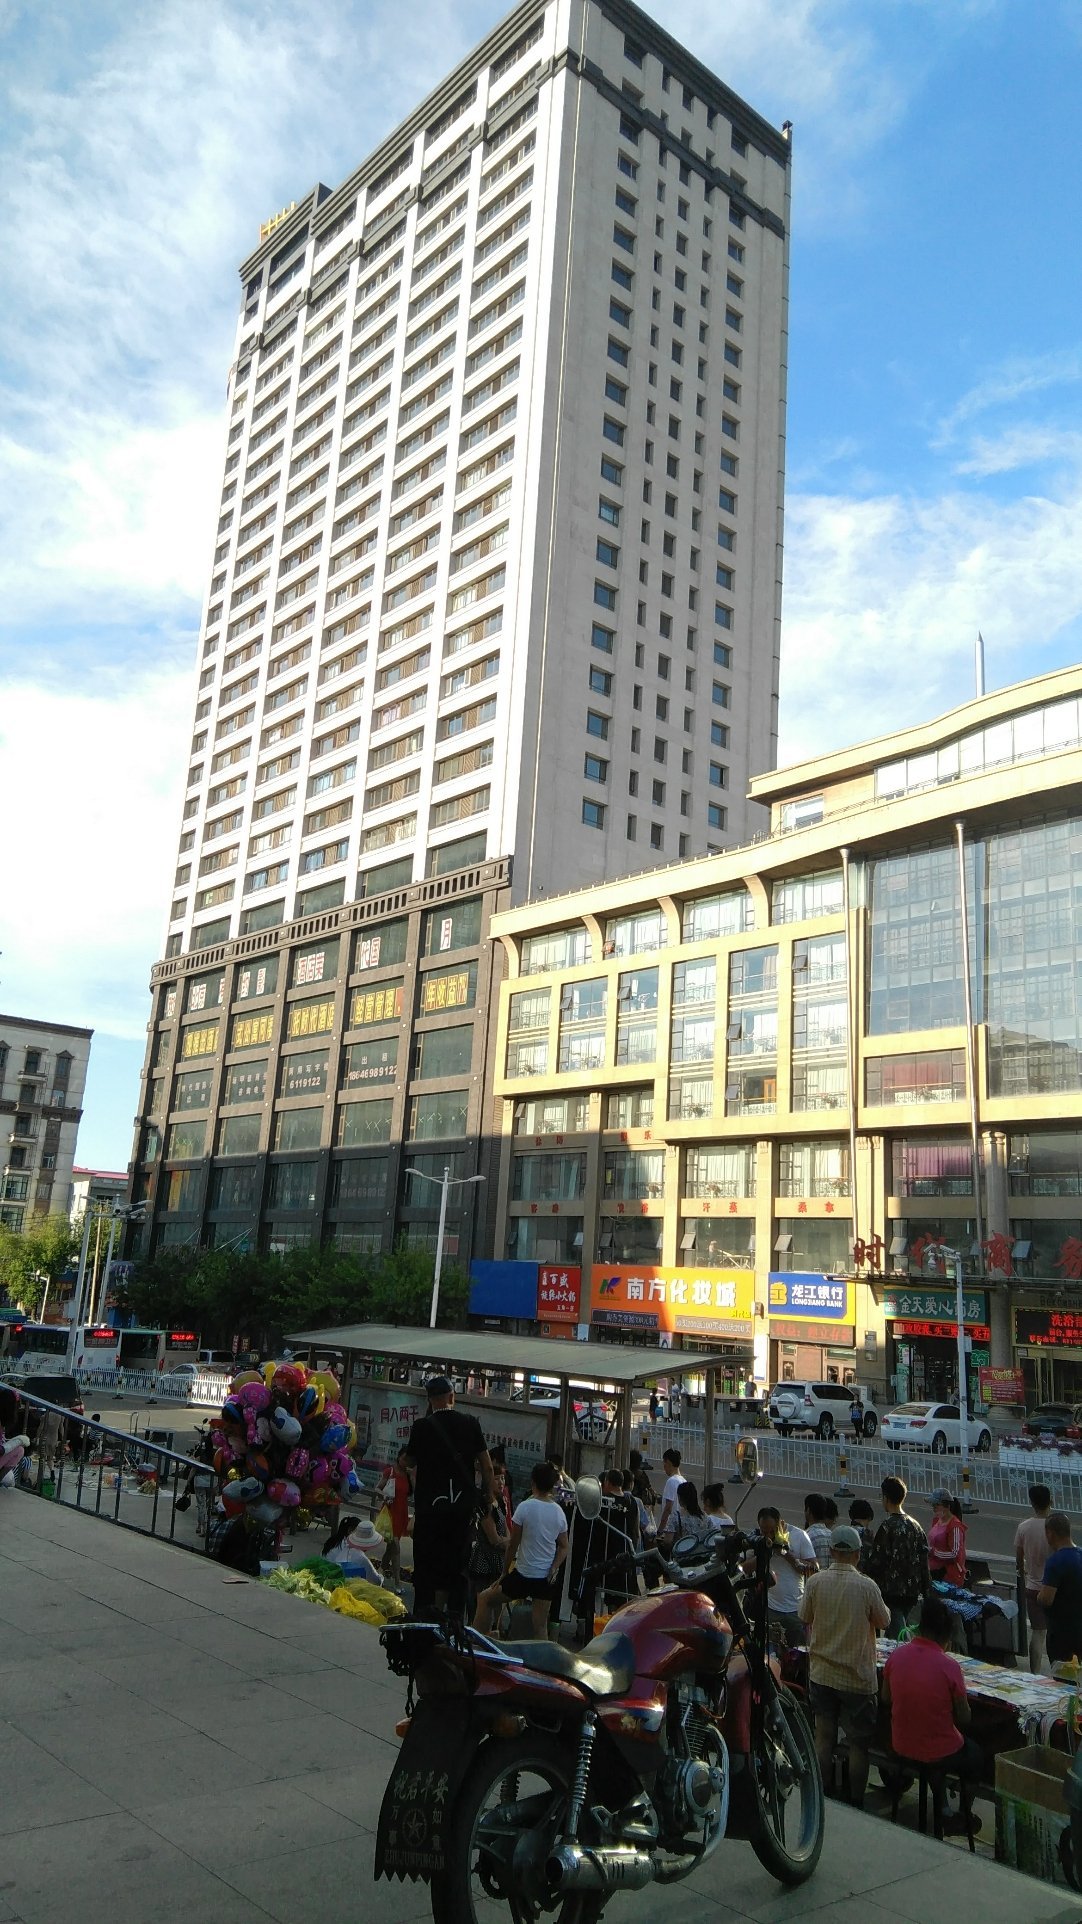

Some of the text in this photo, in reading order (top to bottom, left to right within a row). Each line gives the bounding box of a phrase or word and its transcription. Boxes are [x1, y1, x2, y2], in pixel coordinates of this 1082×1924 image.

[289, 1076, 321, 1089] 6119122
[627, 1277, 736, 1308] 南方化妆城
[791, 1285, 843, 1300] 龙江银行
[826, 1300, 843, 1308] BANK
[380, 1405, 419, 1423] 月入两千
